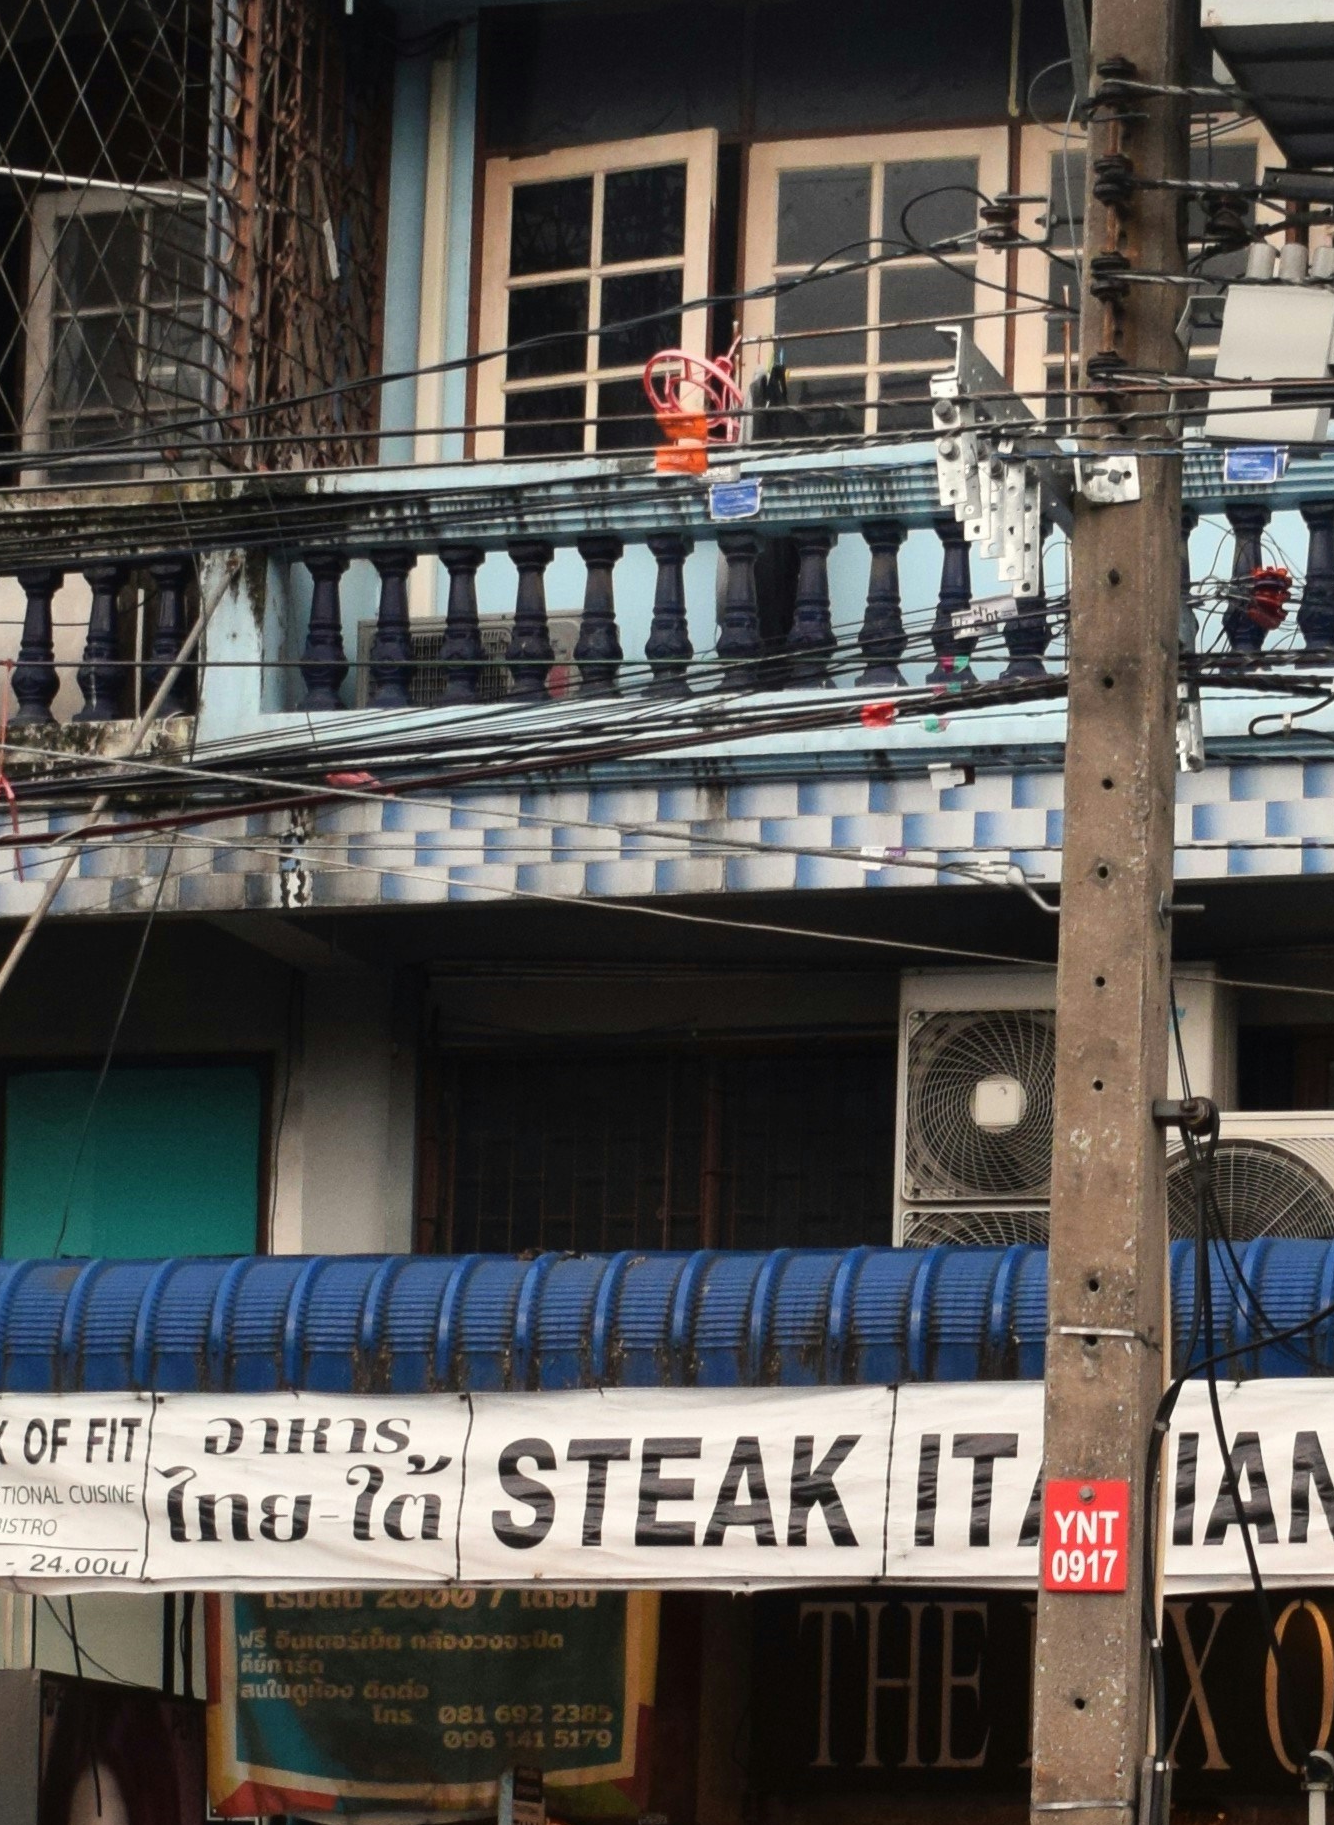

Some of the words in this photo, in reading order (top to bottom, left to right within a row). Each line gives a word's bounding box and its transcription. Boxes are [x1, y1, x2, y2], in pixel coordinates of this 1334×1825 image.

[23, 1418, 71, 1464] OF
[86, 1418, 142, 1463] FIT
[204, 1417, 411, 1456] อาหาร
[69, 1484, 135, 1504] CUISINE
[492, 1434, 859, 1549] STEAK
[1054, 1510, 1119, 1546] YNT
[30, 1553, 128, 1575] 24.00น
[1051, 1548, 1117, 1585] 0917
[798, 1600, 990, 1770] THE
[438, 1704, 486, 1725] 081
[494, 1704, 544, 1725] 692
[551, 1704, 614, 1725] 2385
[443, 1728, 496, 1750] 096
[505, 1728, 546, 1750] 141
[553, 1728, 613, 1750] 5179
